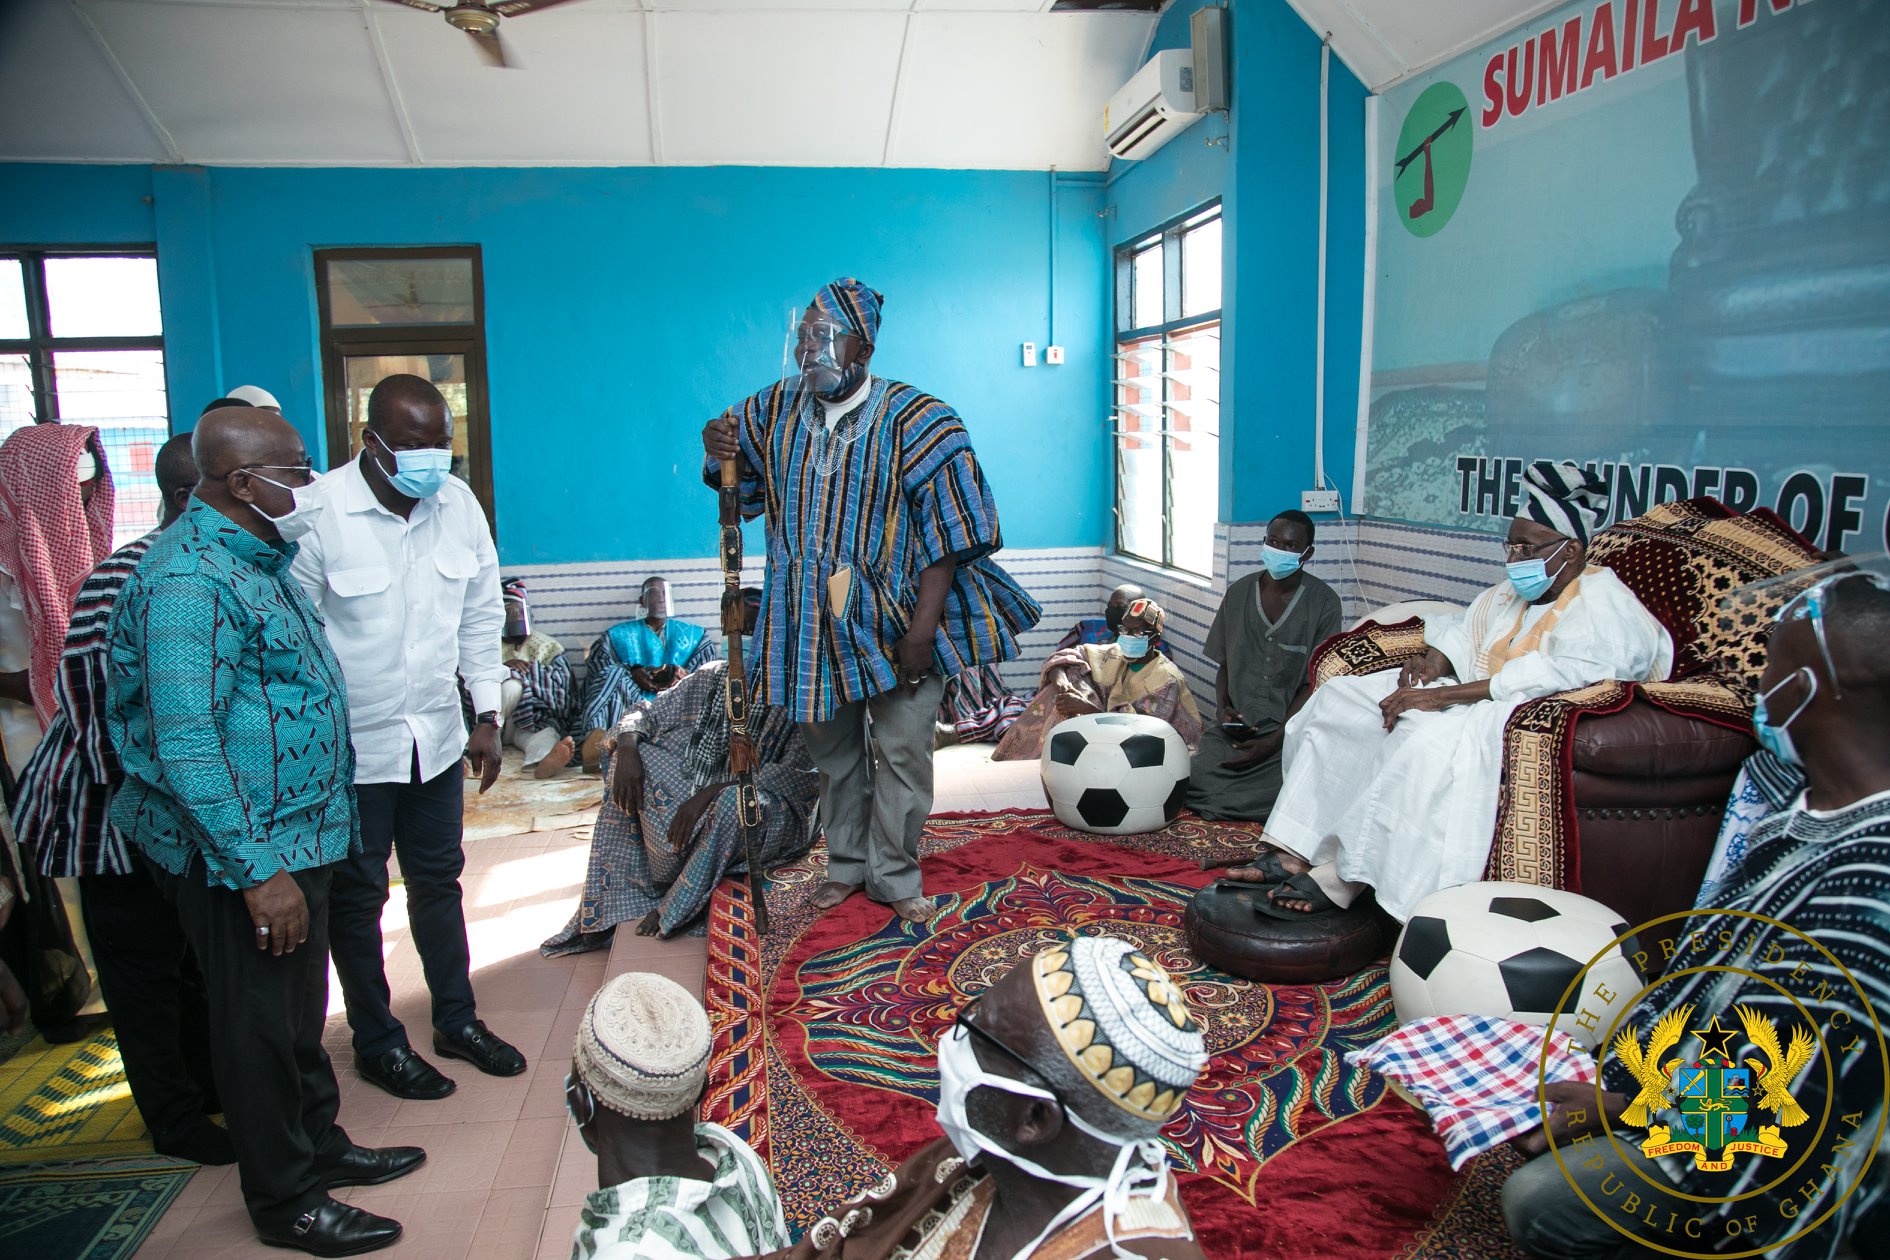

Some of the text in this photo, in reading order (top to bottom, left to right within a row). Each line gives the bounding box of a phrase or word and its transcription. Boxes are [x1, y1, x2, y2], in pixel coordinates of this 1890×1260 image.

[1482, 0, 1718, 129] SUMAILA
[1457, 456, 1524, 519] THE
[1776, 470, 1868, 552] OF
